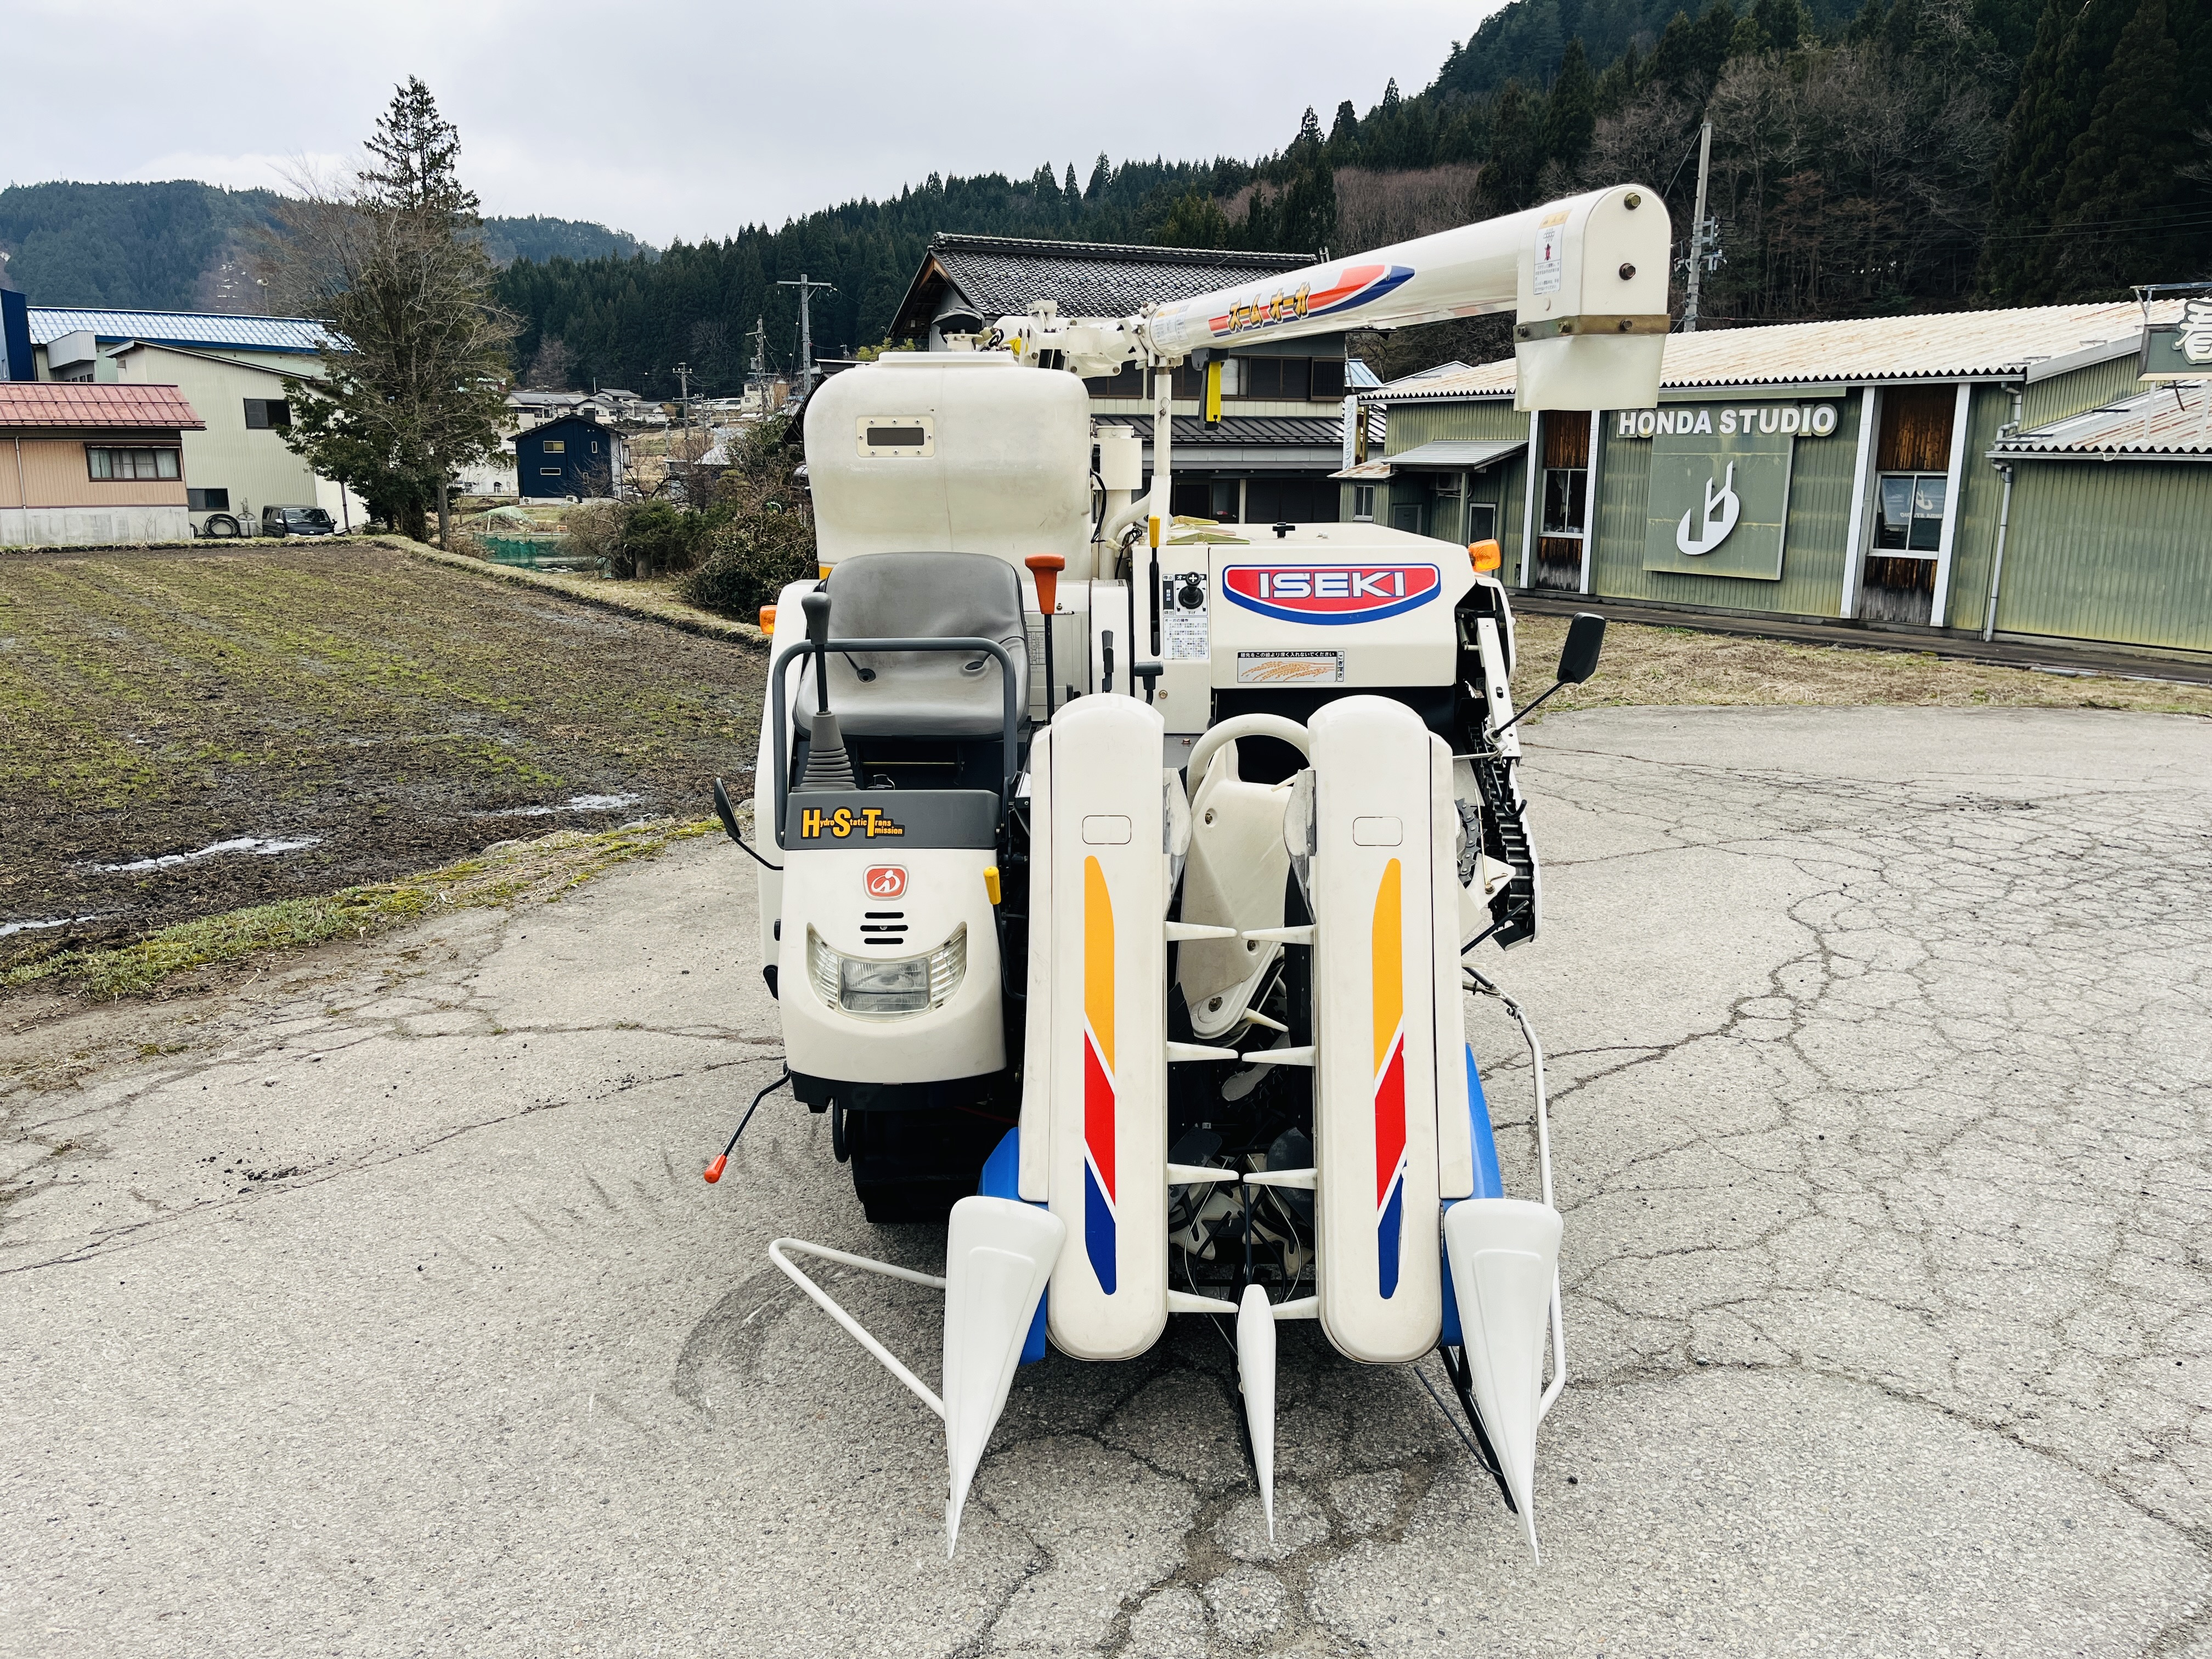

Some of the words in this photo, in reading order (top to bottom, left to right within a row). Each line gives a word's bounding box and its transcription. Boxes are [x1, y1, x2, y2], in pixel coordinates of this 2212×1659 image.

[1618, 410, 1713, 435] HONDA
[1719, 406, 1835, 435] STUDIO
[1259, 570, 1406, 599] ISEKI
